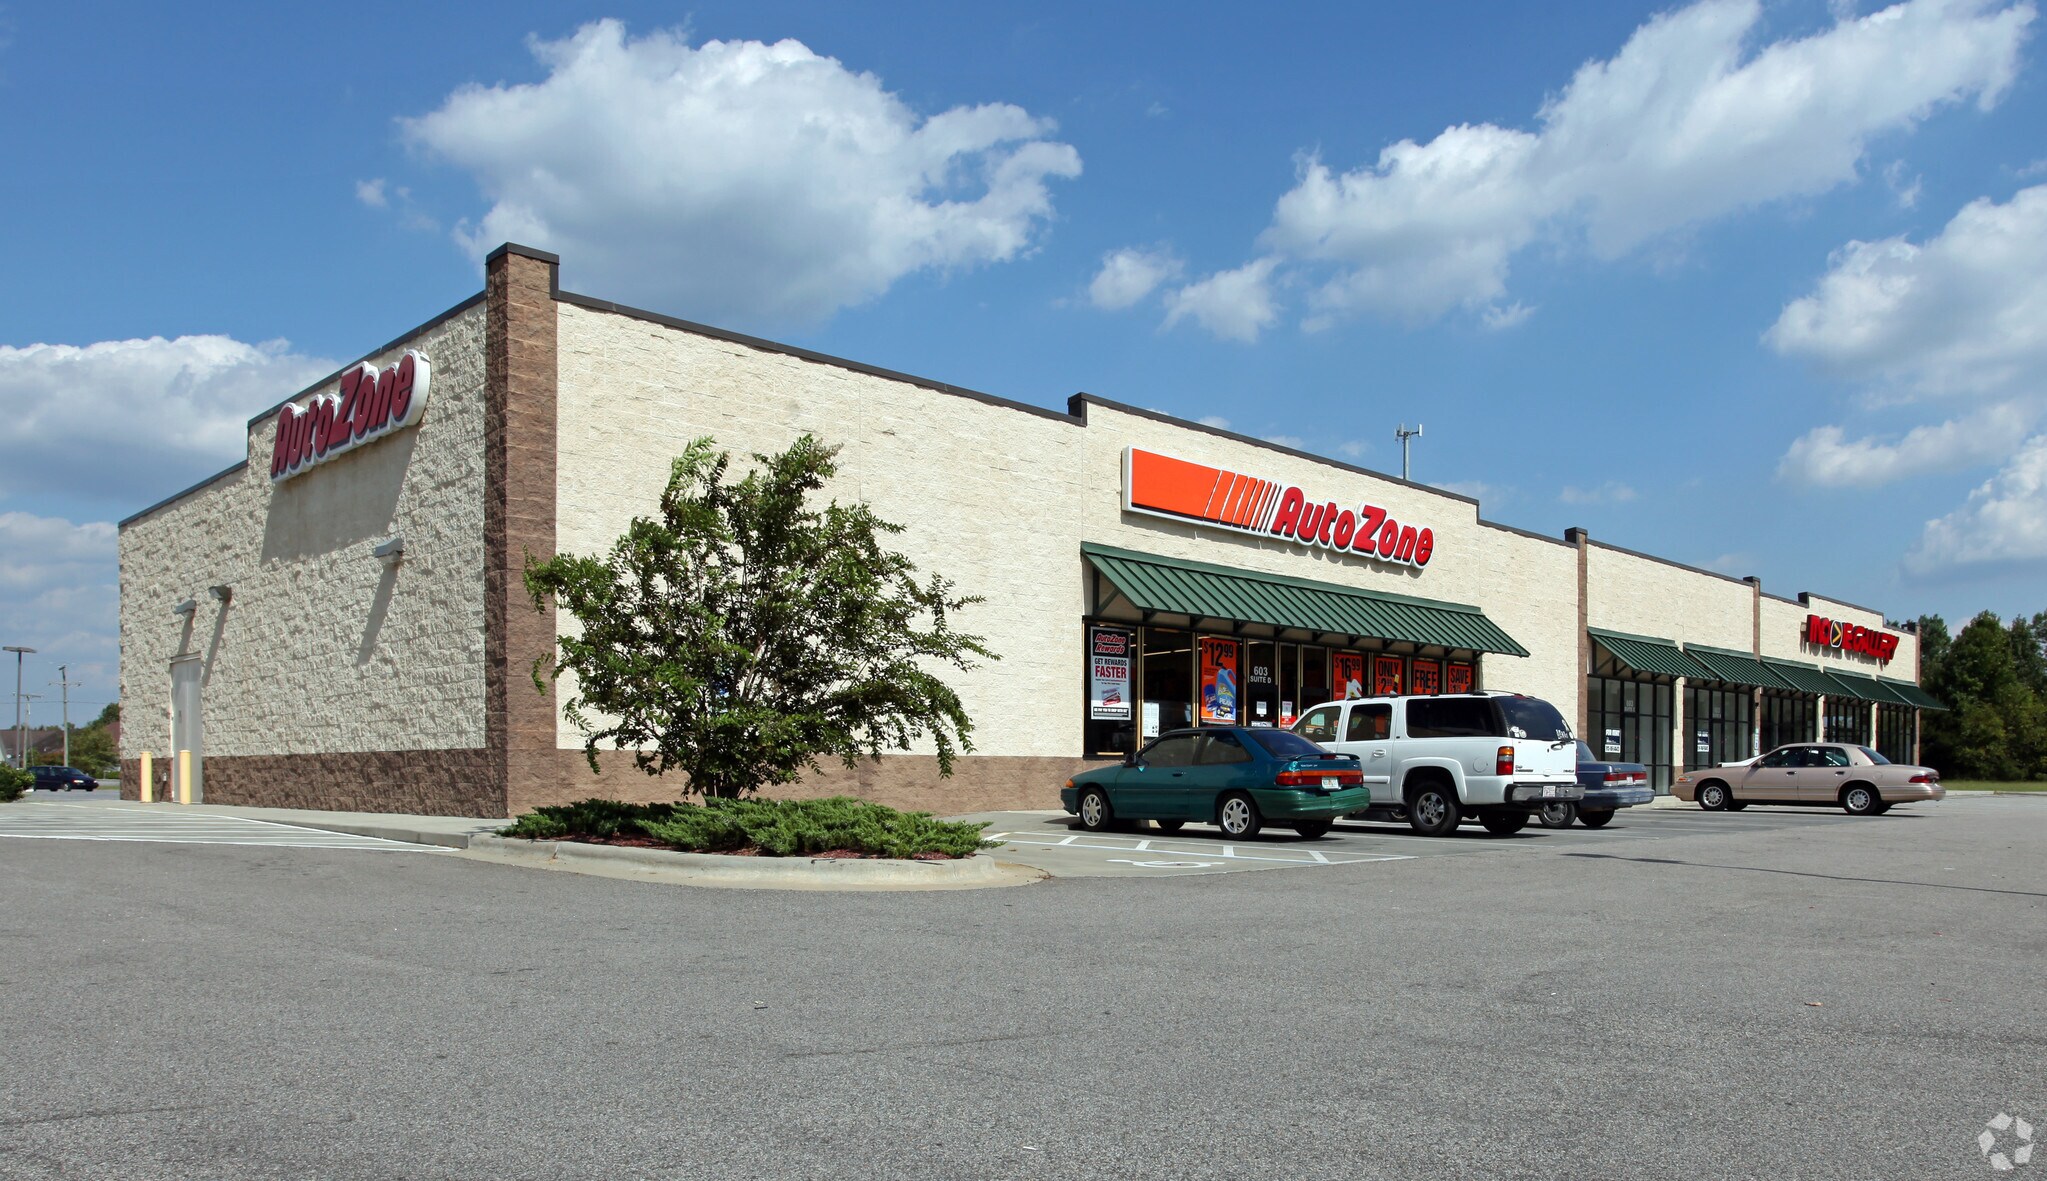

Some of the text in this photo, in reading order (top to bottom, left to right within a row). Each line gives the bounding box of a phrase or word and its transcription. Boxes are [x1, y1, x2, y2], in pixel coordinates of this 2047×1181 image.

[270, 353, 415, 478] AutoZone
[1270, 486, 1434, 567] AutoZone
[1095, 633, 1126, 645] AutoZone
[1095, 643, 1125, 654] Rewards
[1095, 666, 1127, 678] FASTER
[1253, 666, 1268, 676] 603
[1378, 661, 1399, 677] ONLY
[1450, 668, 1470, 684] SAVE
[1250, 675, 1266, 683] SUITE
[1414, 669, 1437, 688] FREE
